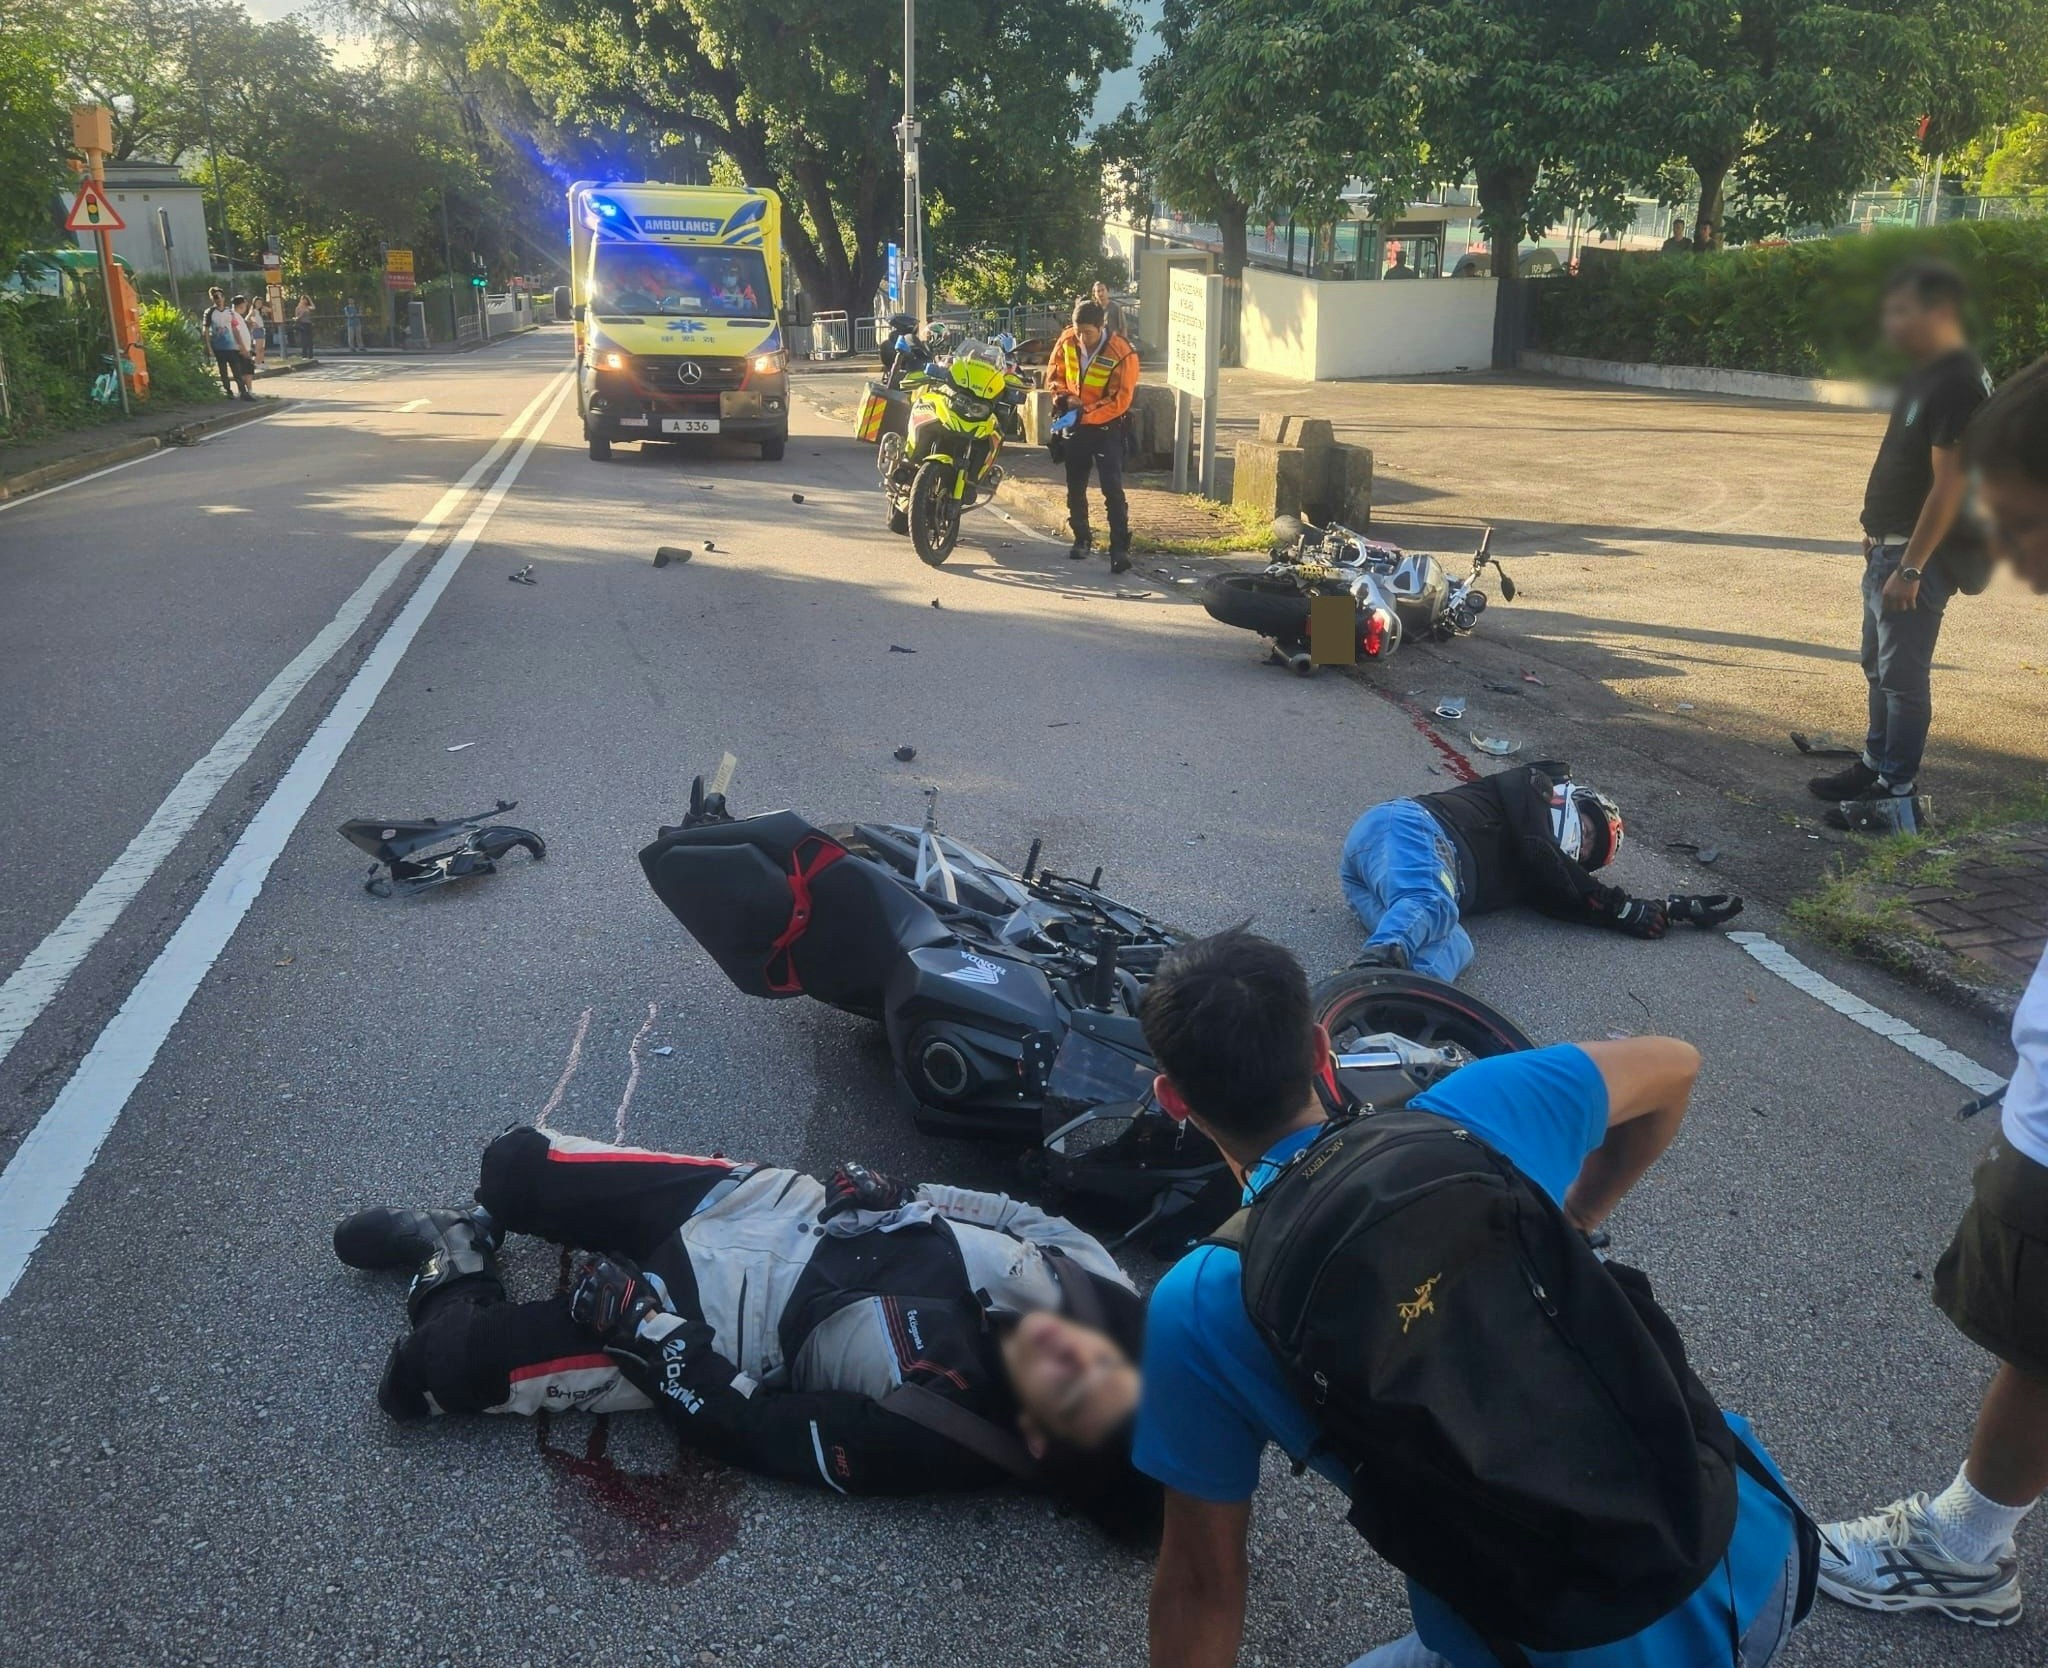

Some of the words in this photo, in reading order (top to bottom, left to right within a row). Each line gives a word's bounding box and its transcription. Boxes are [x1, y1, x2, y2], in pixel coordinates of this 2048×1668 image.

[644, 219, 716, 233] AMBULANCE
[672, 421, 680, 431] A
[685, 421, 709, 432] 336
[960, 950, 1007, 976] HONDA
